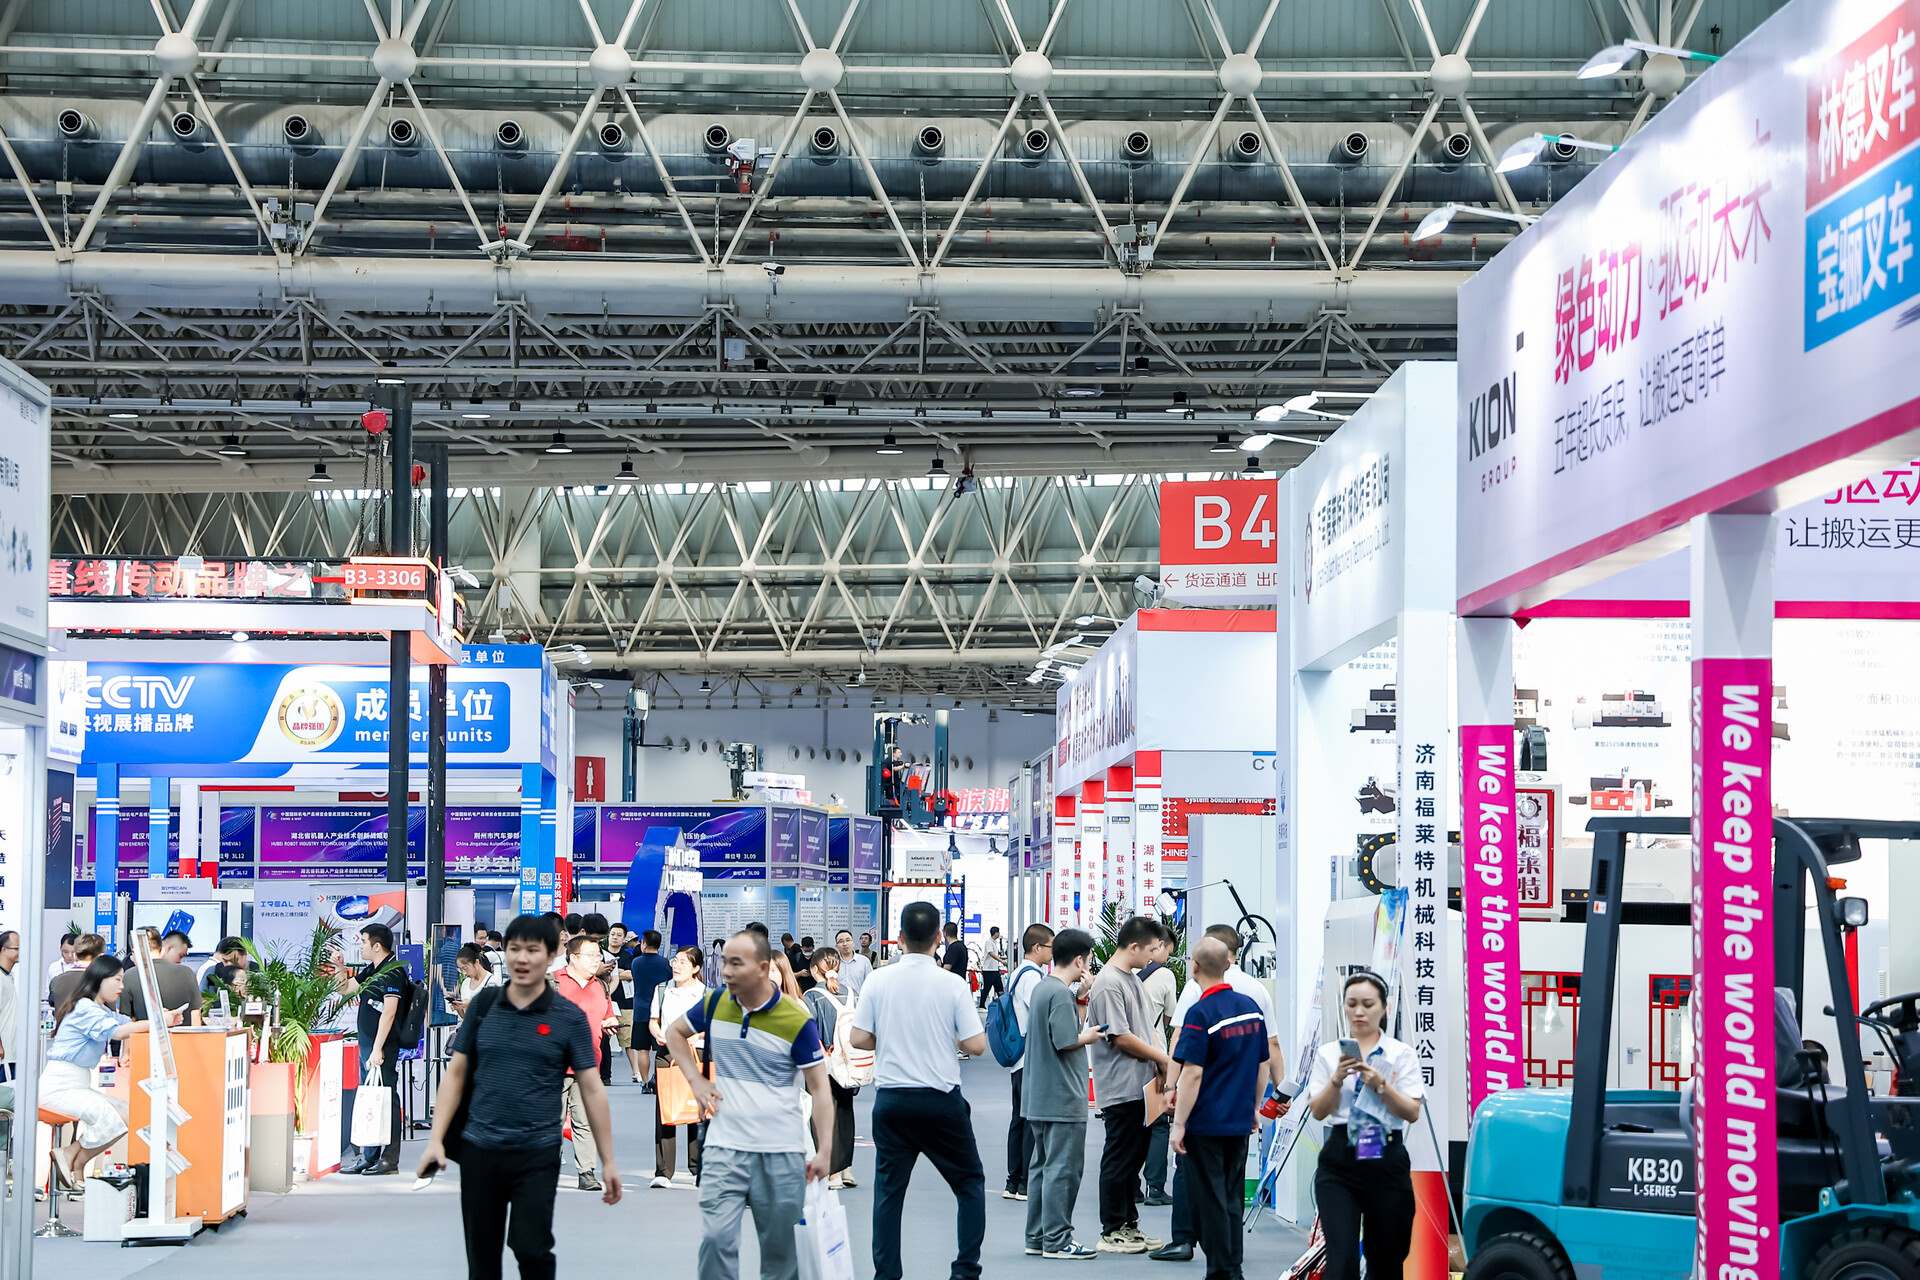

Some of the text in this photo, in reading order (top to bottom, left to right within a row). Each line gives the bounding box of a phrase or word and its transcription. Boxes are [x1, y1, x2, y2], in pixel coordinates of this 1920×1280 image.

[1818, 27, 1916, 184] 林德叉车
[1816, 180, 1914, 323] 宝骊叉车
[1639, 315, 1726, 427] 让搬运更简单
[1470, 371, 1516, 461] KION
[1482, 455, 1517, 493] GROUP
[1193, 494, 1276, 550] B4
[1785, 517, 1920, 549] 让搬运更
[344, 569, 421, 586] B3-3306
[1185, 572, 1248, 588] 货运通道
[451, 728, 493, 742] units
[1722, 685, 1760, 752] We
[1477, 745, 1506, 796] We
[474, 832, 521, 840] 荆州市汽车零部
[1474, 801, 1509, 887] keep
[1714, 758, 1762, 874] keep
[1414, 743, 1436, 1088] 济南福莱特机械科技有限公司
[1481, 895, 1511, 952] the
[1722, 883, 1762, 962] the
[1483, 961, 1516, 1063] world
[1724, 973, 1766, 1110] world
[1628, 1157, 1683, 1184] KB30
[1633, 1184, 1677, 1198] L-SERIES
